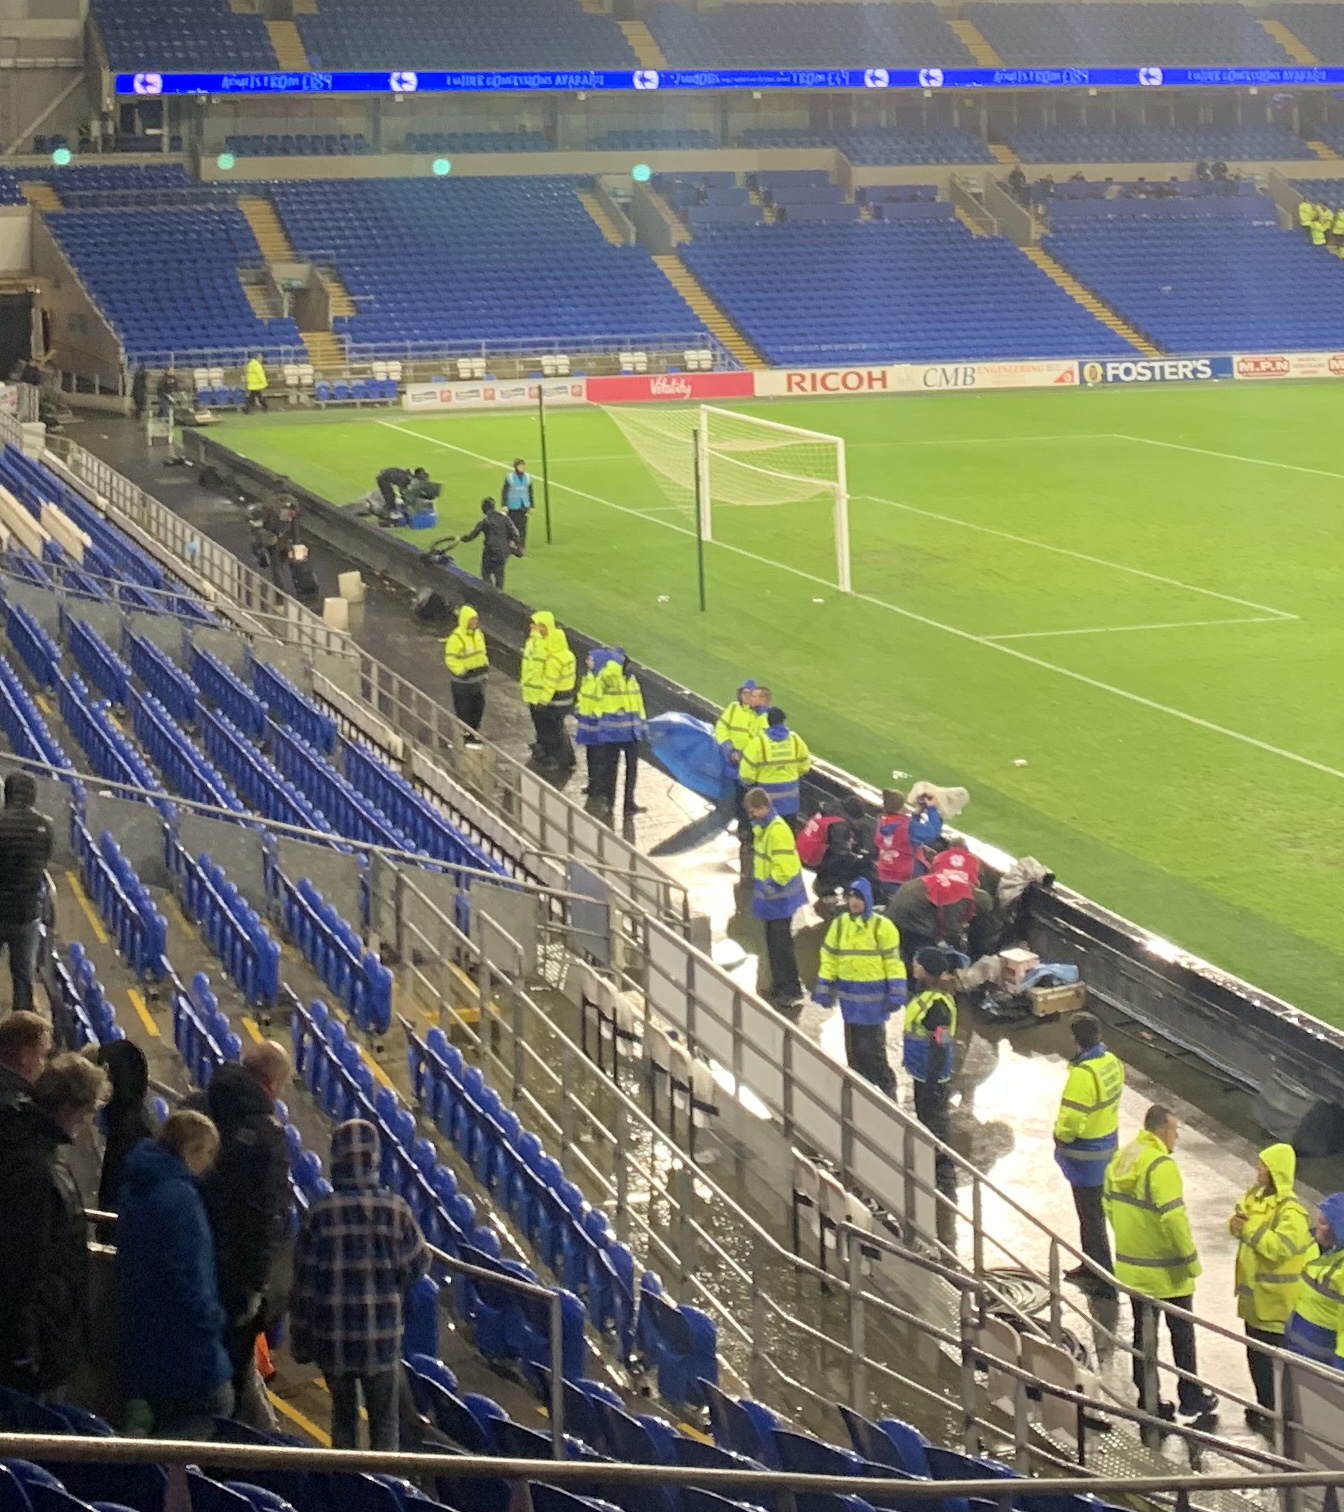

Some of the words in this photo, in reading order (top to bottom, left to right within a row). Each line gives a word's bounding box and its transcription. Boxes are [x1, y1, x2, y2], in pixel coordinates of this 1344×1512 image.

[922, 366, 976, 388] CMB
[977, 363, 1045, 375] ENGINEERING
[1106, 360, 1213, 384] FOSTER'S
[1238, 360, 1289, 372] M.P.N
[650, 376, 691, 399] Vitality
[786, 370, 888, 393] RICOH
